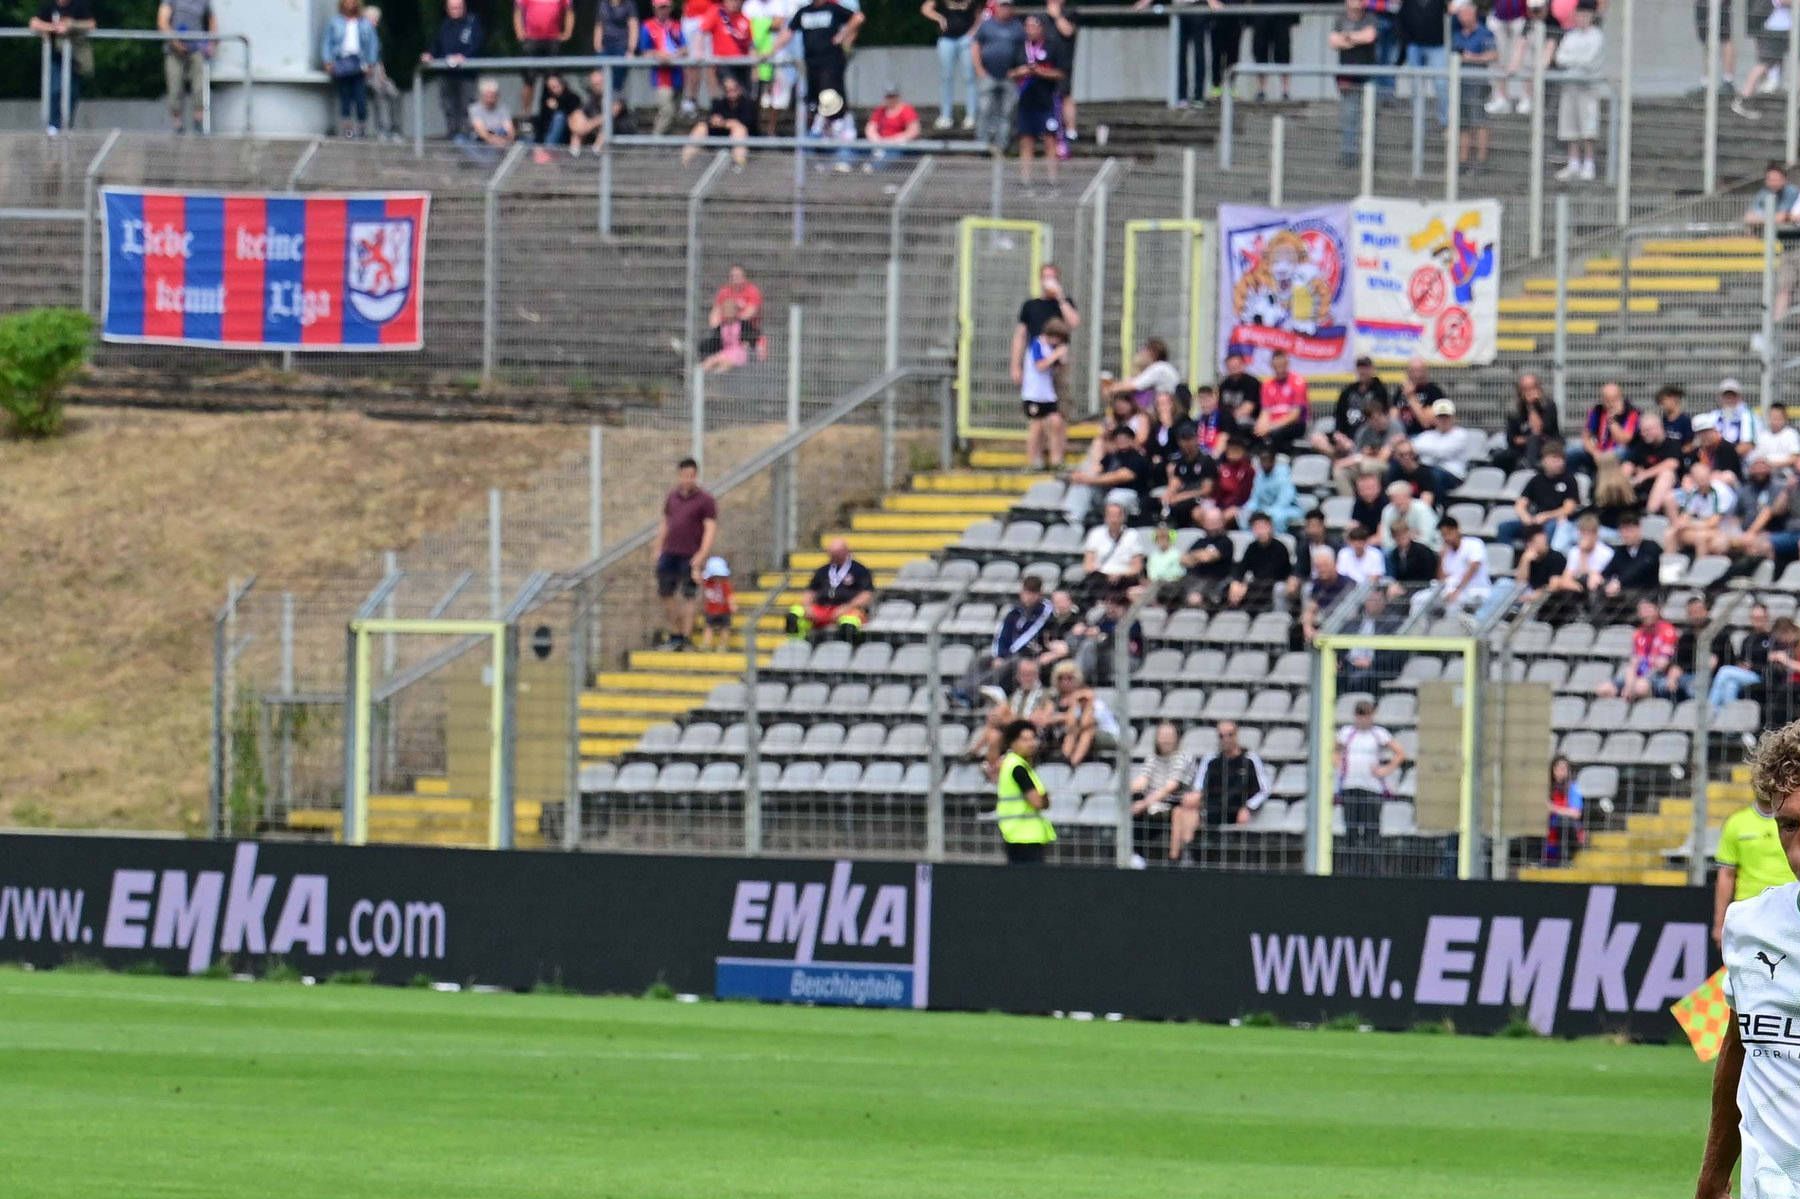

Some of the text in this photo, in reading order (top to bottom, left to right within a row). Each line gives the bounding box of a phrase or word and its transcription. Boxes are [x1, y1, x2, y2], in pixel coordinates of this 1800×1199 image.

[121, 218, 304, 261] Liebe keine
[155, 277, 331, 326] kennt Liga
[790, 969, 905, 1004] Beschlagteile
